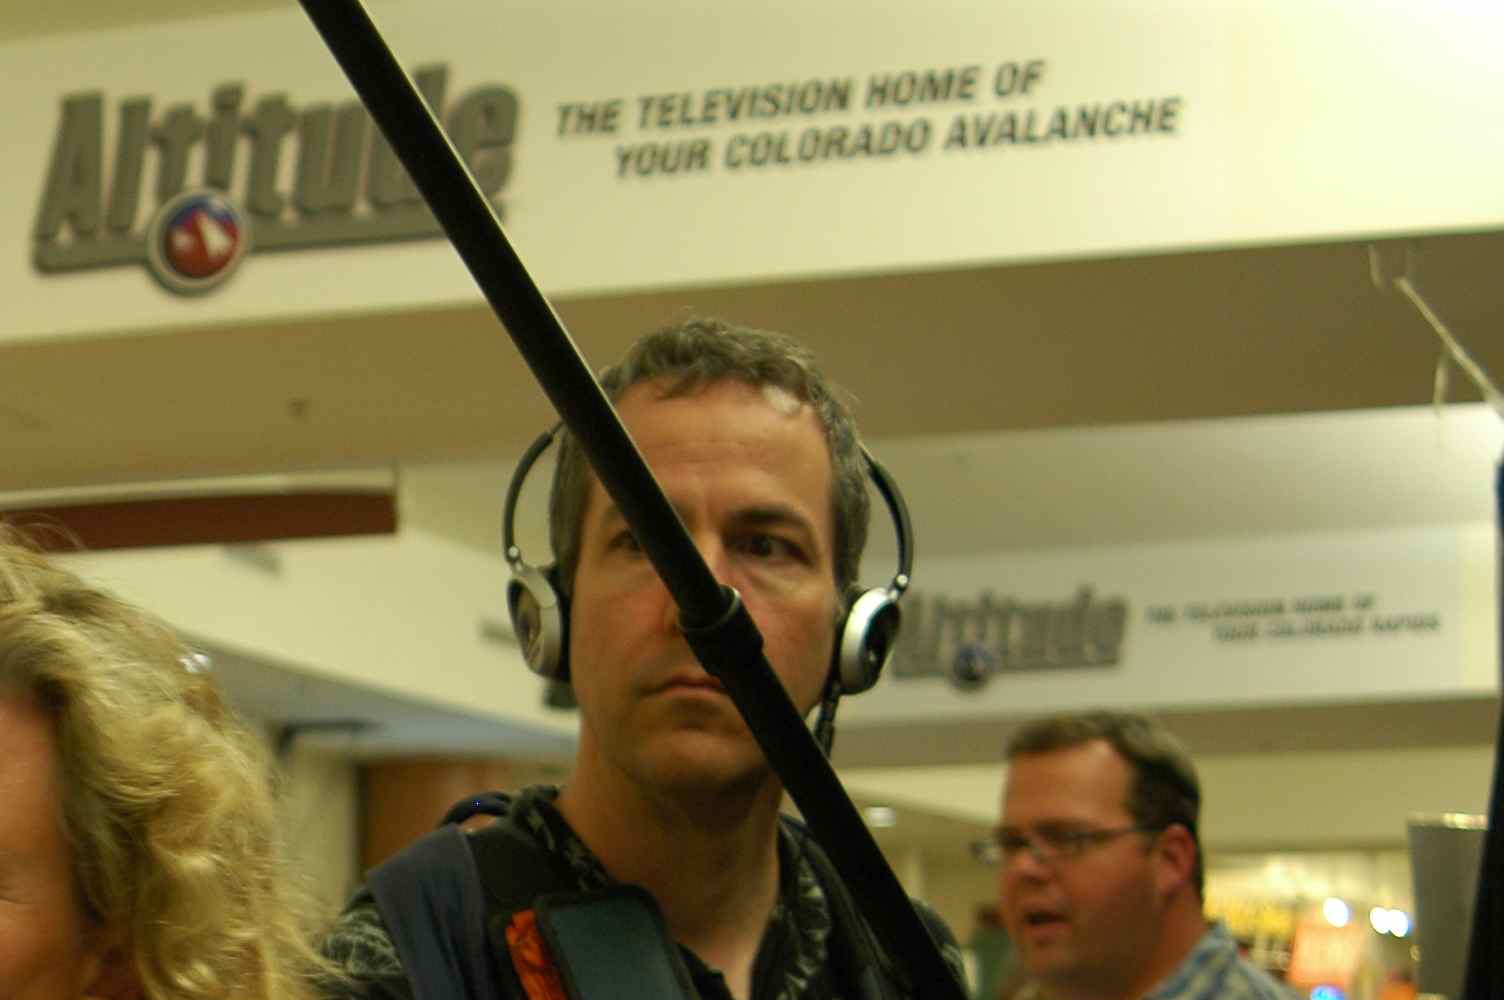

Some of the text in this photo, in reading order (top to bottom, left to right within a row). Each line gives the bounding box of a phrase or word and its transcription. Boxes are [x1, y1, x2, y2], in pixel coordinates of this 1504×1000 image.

[555, 58, 1045, 140] THE TELEVISION HOME OF
[614, 97, 1184, 178] YOUR COLORADO AVALANCHE
